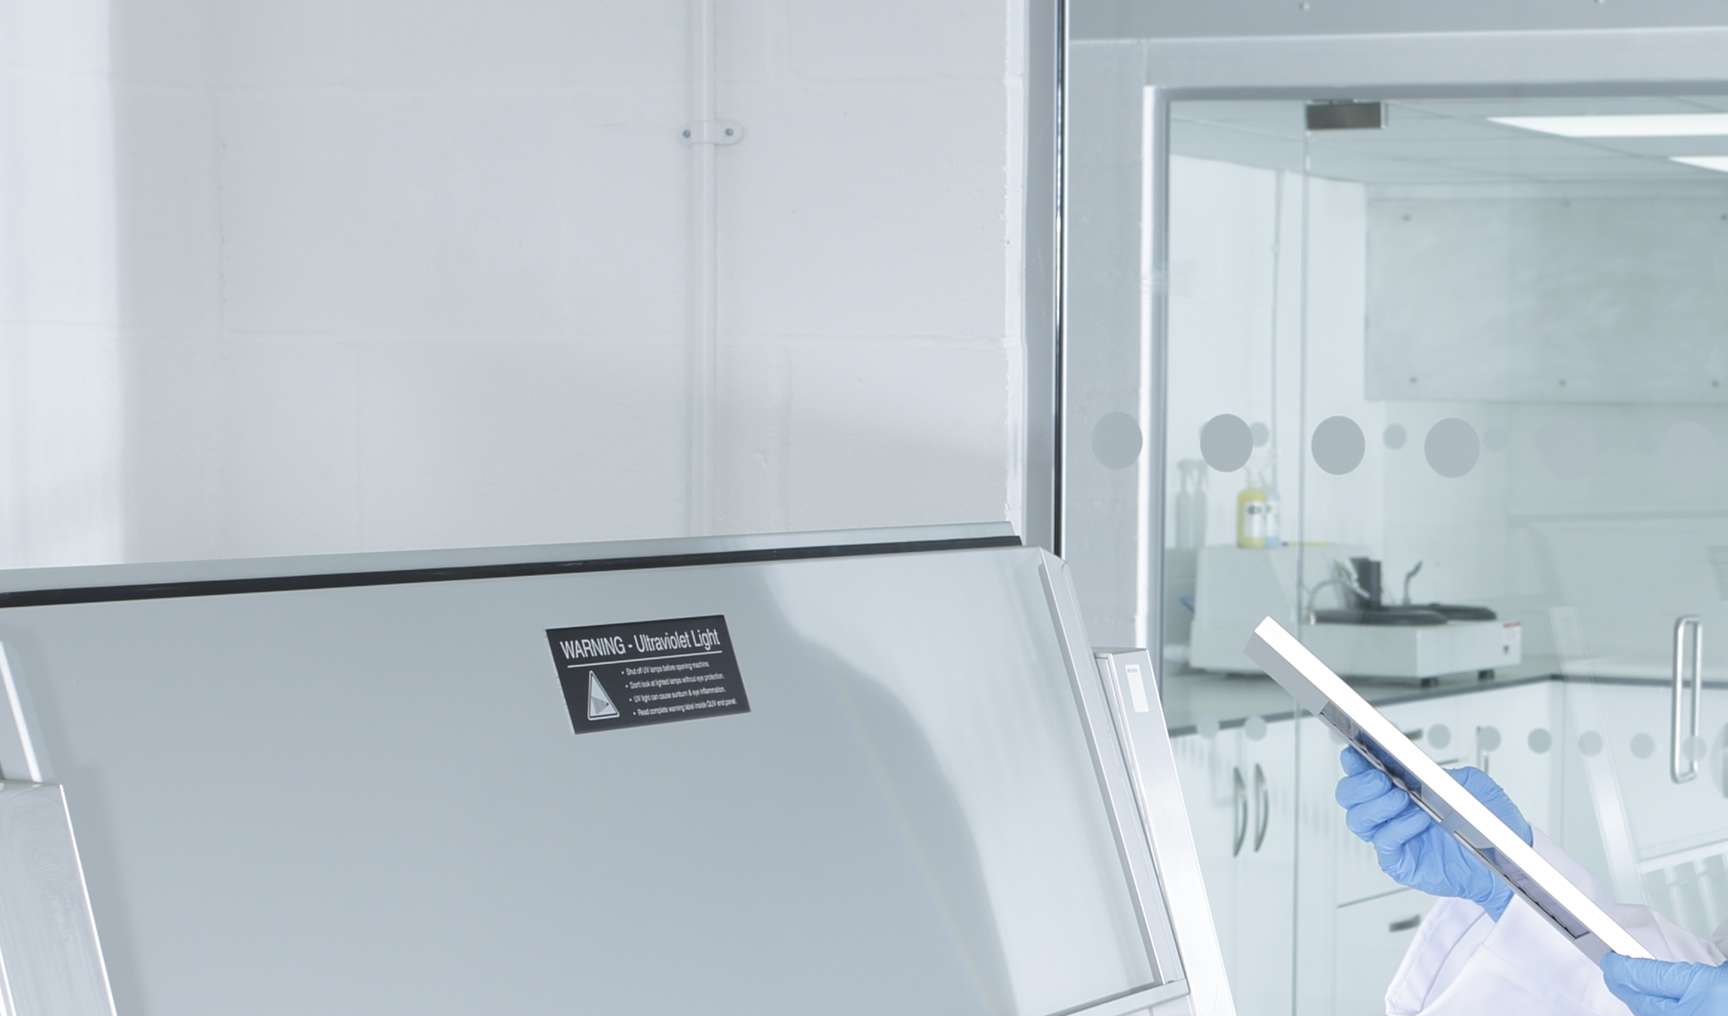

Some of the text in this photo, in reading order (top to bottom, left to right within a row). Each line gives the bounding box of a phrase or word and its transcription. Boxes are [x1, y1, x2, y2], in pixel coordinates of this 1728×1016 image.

[560, 636, 625, 658] WARNING
[633, 631, 690, 651] Ultraviolet
[691, 628, 720, 650] Light
